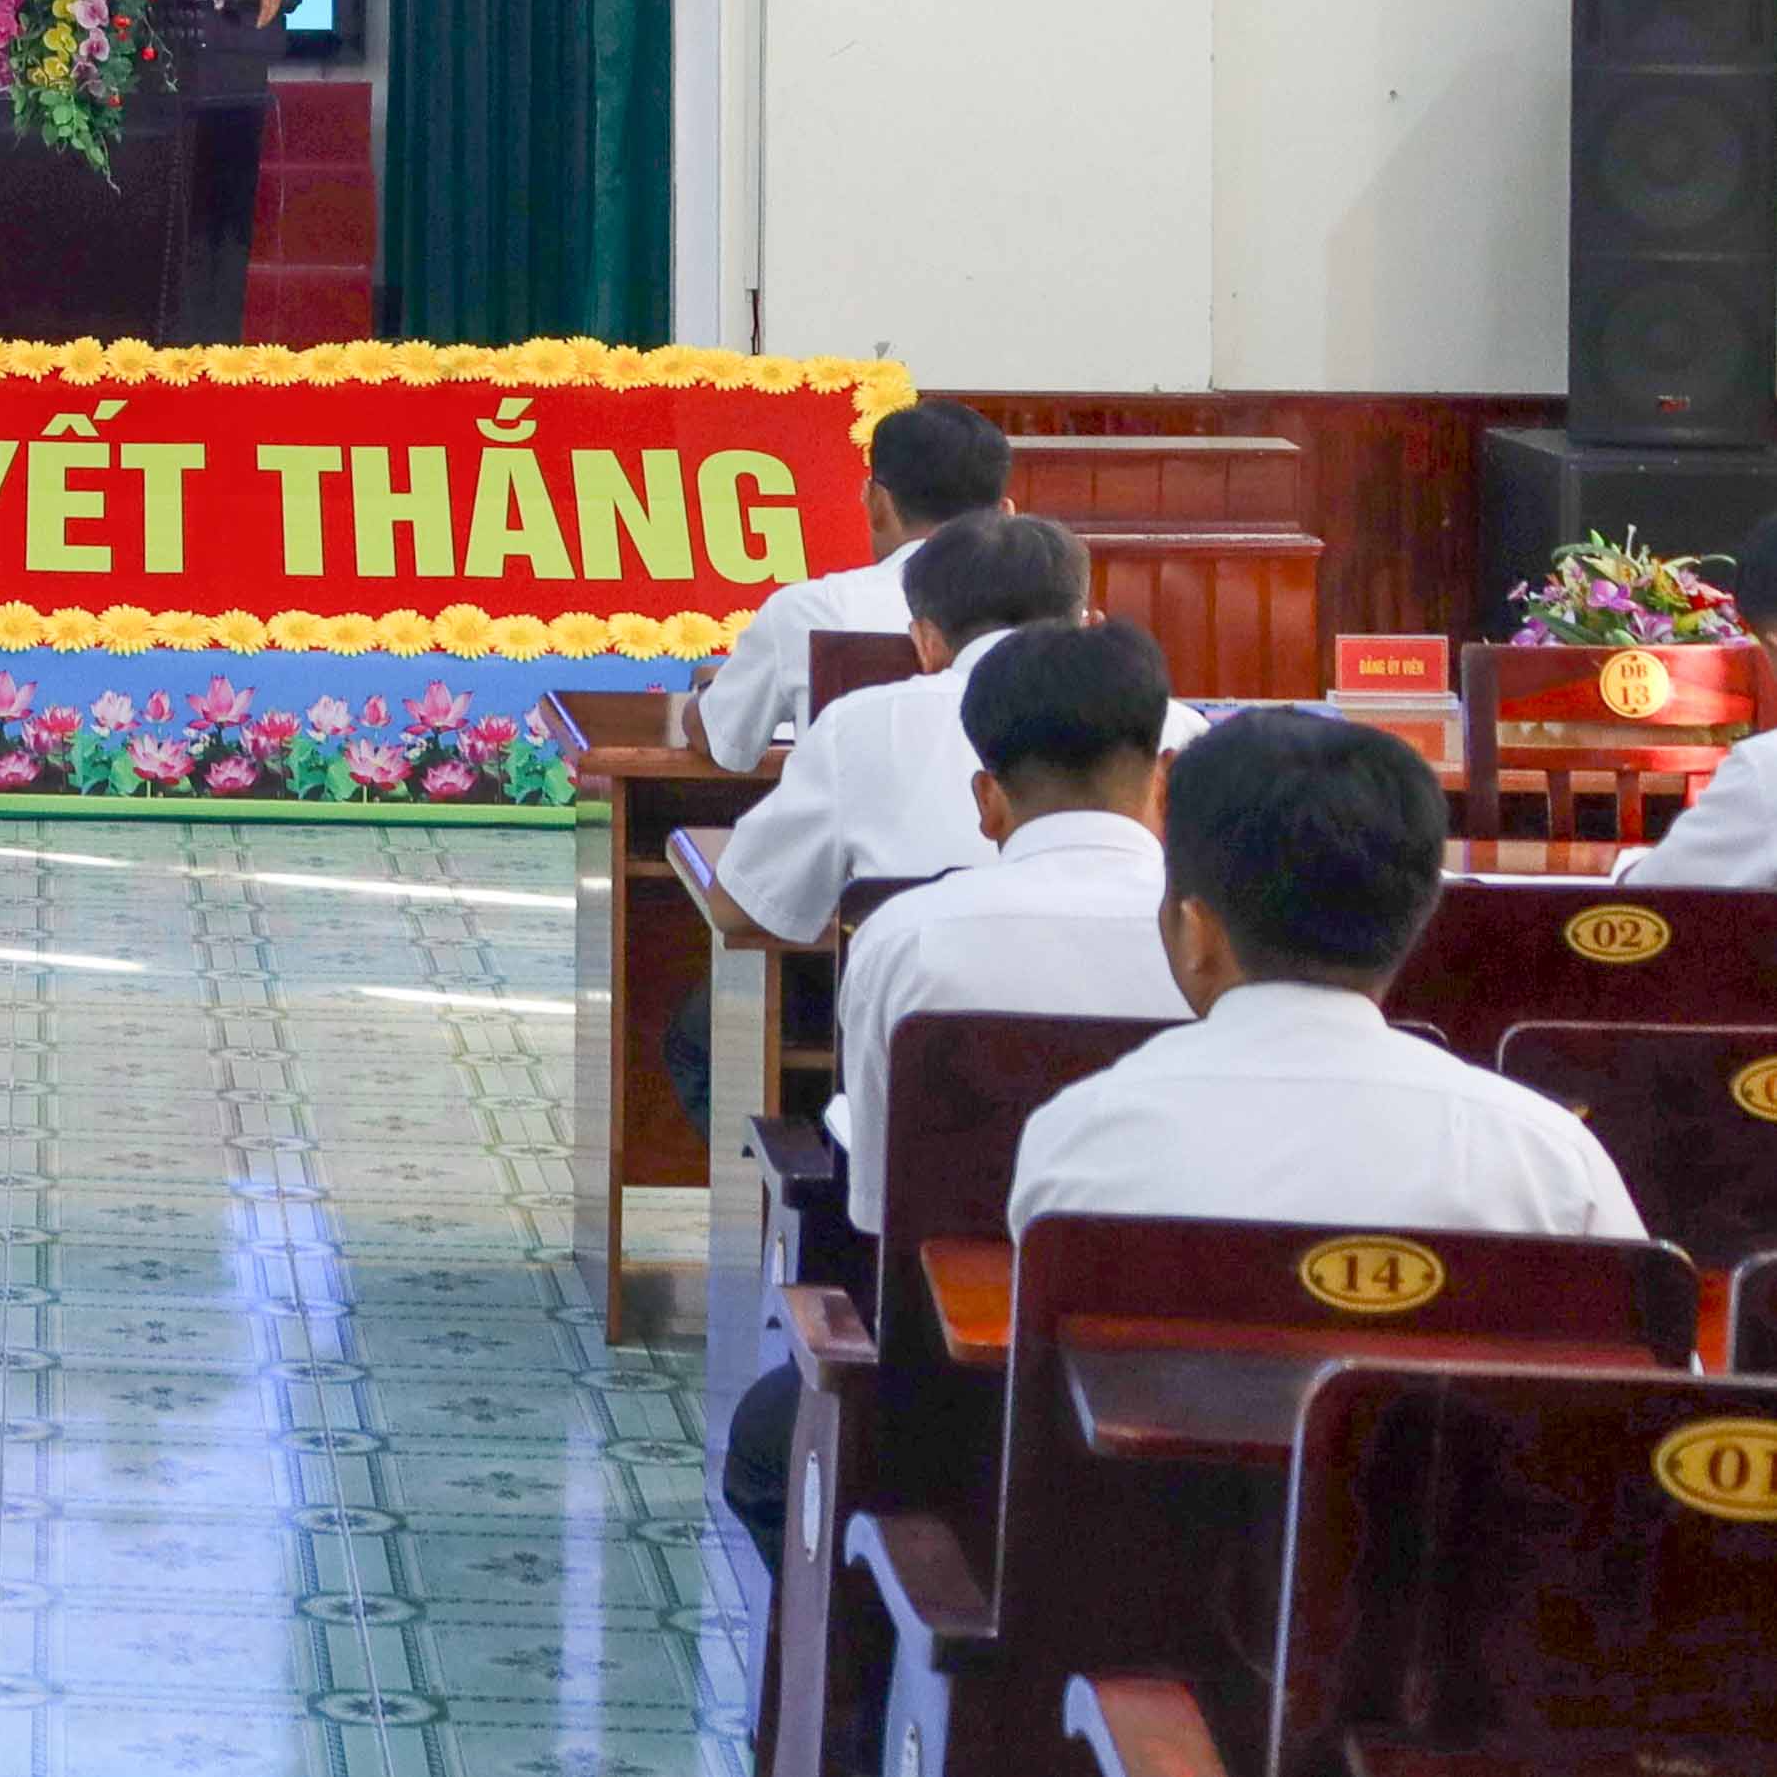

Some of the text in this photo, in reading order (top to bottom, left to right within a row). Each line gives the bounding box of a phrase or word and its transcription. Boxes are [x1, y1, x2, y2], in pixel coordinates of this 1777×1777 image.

[260, 398, 807, 583] THẮNG
[1621, 686, 1651, 706] 13
[1593, 916, 1641, 949] 02
[1342, 1254, 1403, 1293] 14
